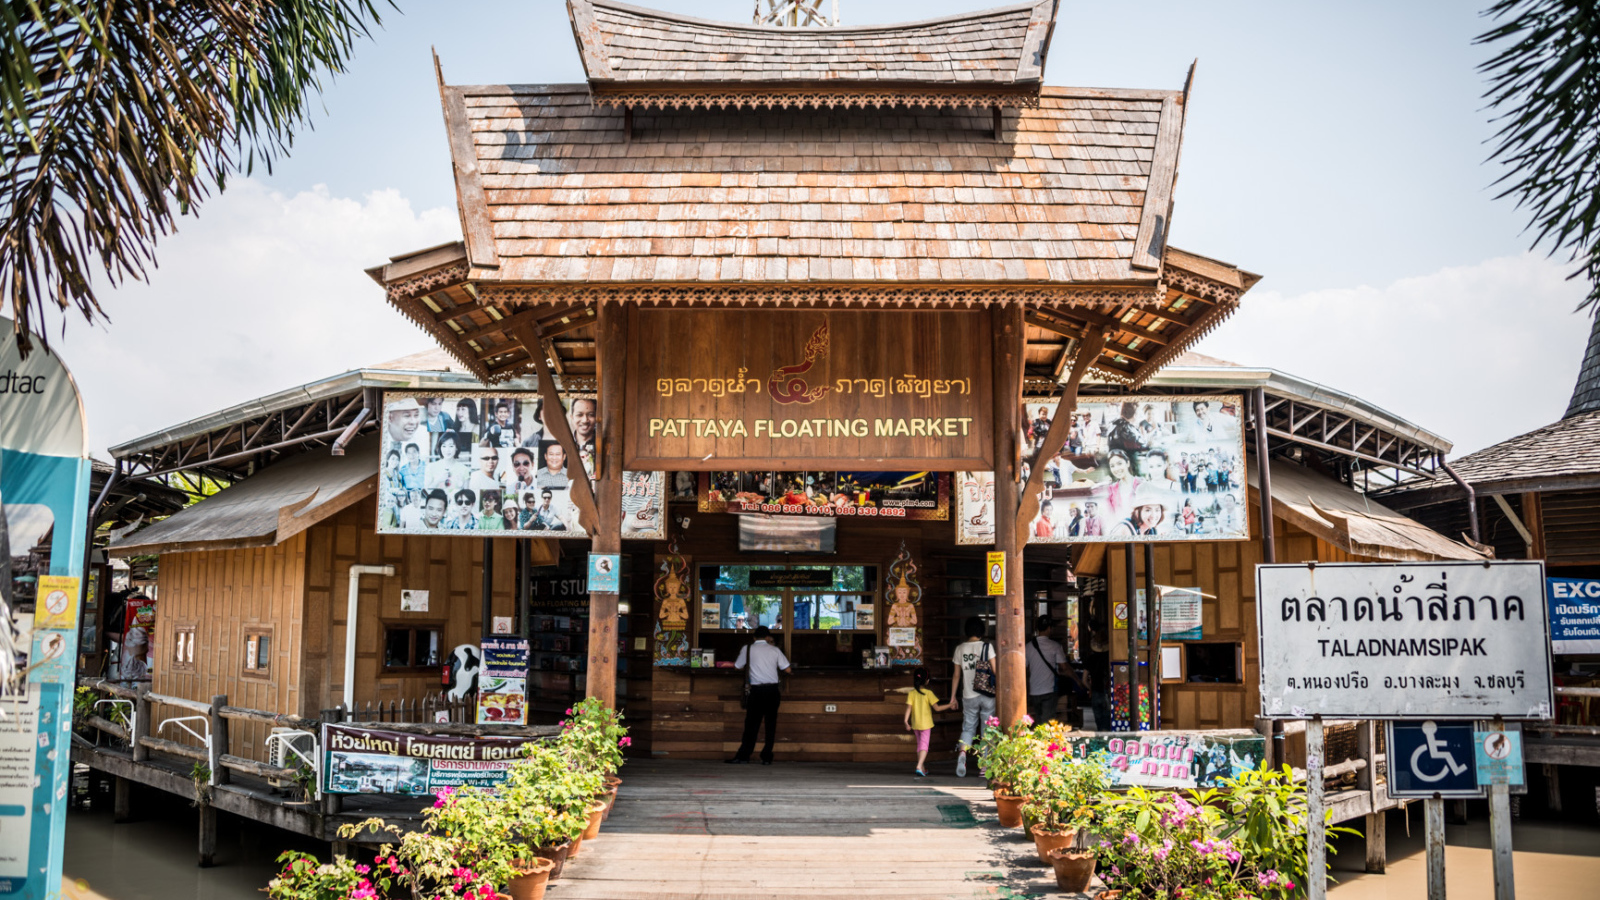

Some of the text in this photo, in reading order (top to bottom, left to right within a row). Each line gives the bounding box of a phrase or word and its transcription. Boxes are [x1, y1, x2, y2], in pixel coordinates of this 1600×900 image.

[0, 369, 46, 394] dtac
[649, 418, 973, 438] PATTAYA FLOATING MARKET
[740, 502, 906, 517] Tel: 086 366 1010, 086 336 4892
[1281, 571, 1525, 622] ตลาดน้ำสี่ภาค
[1552, 581, 1600, 598] EXC
[1318, 637, 1488, 657] TALADNAMSIPAK
[1287, 669, 1525, 695] ต.หนองปรือ อ.บางละมุง จ.ชลบุรี
[331, 731, 400, 756] ห้วยใหญ่
[406, 736, 475, 760] โฮมสเตย์
[1111, 755, 1128, 773] 4
